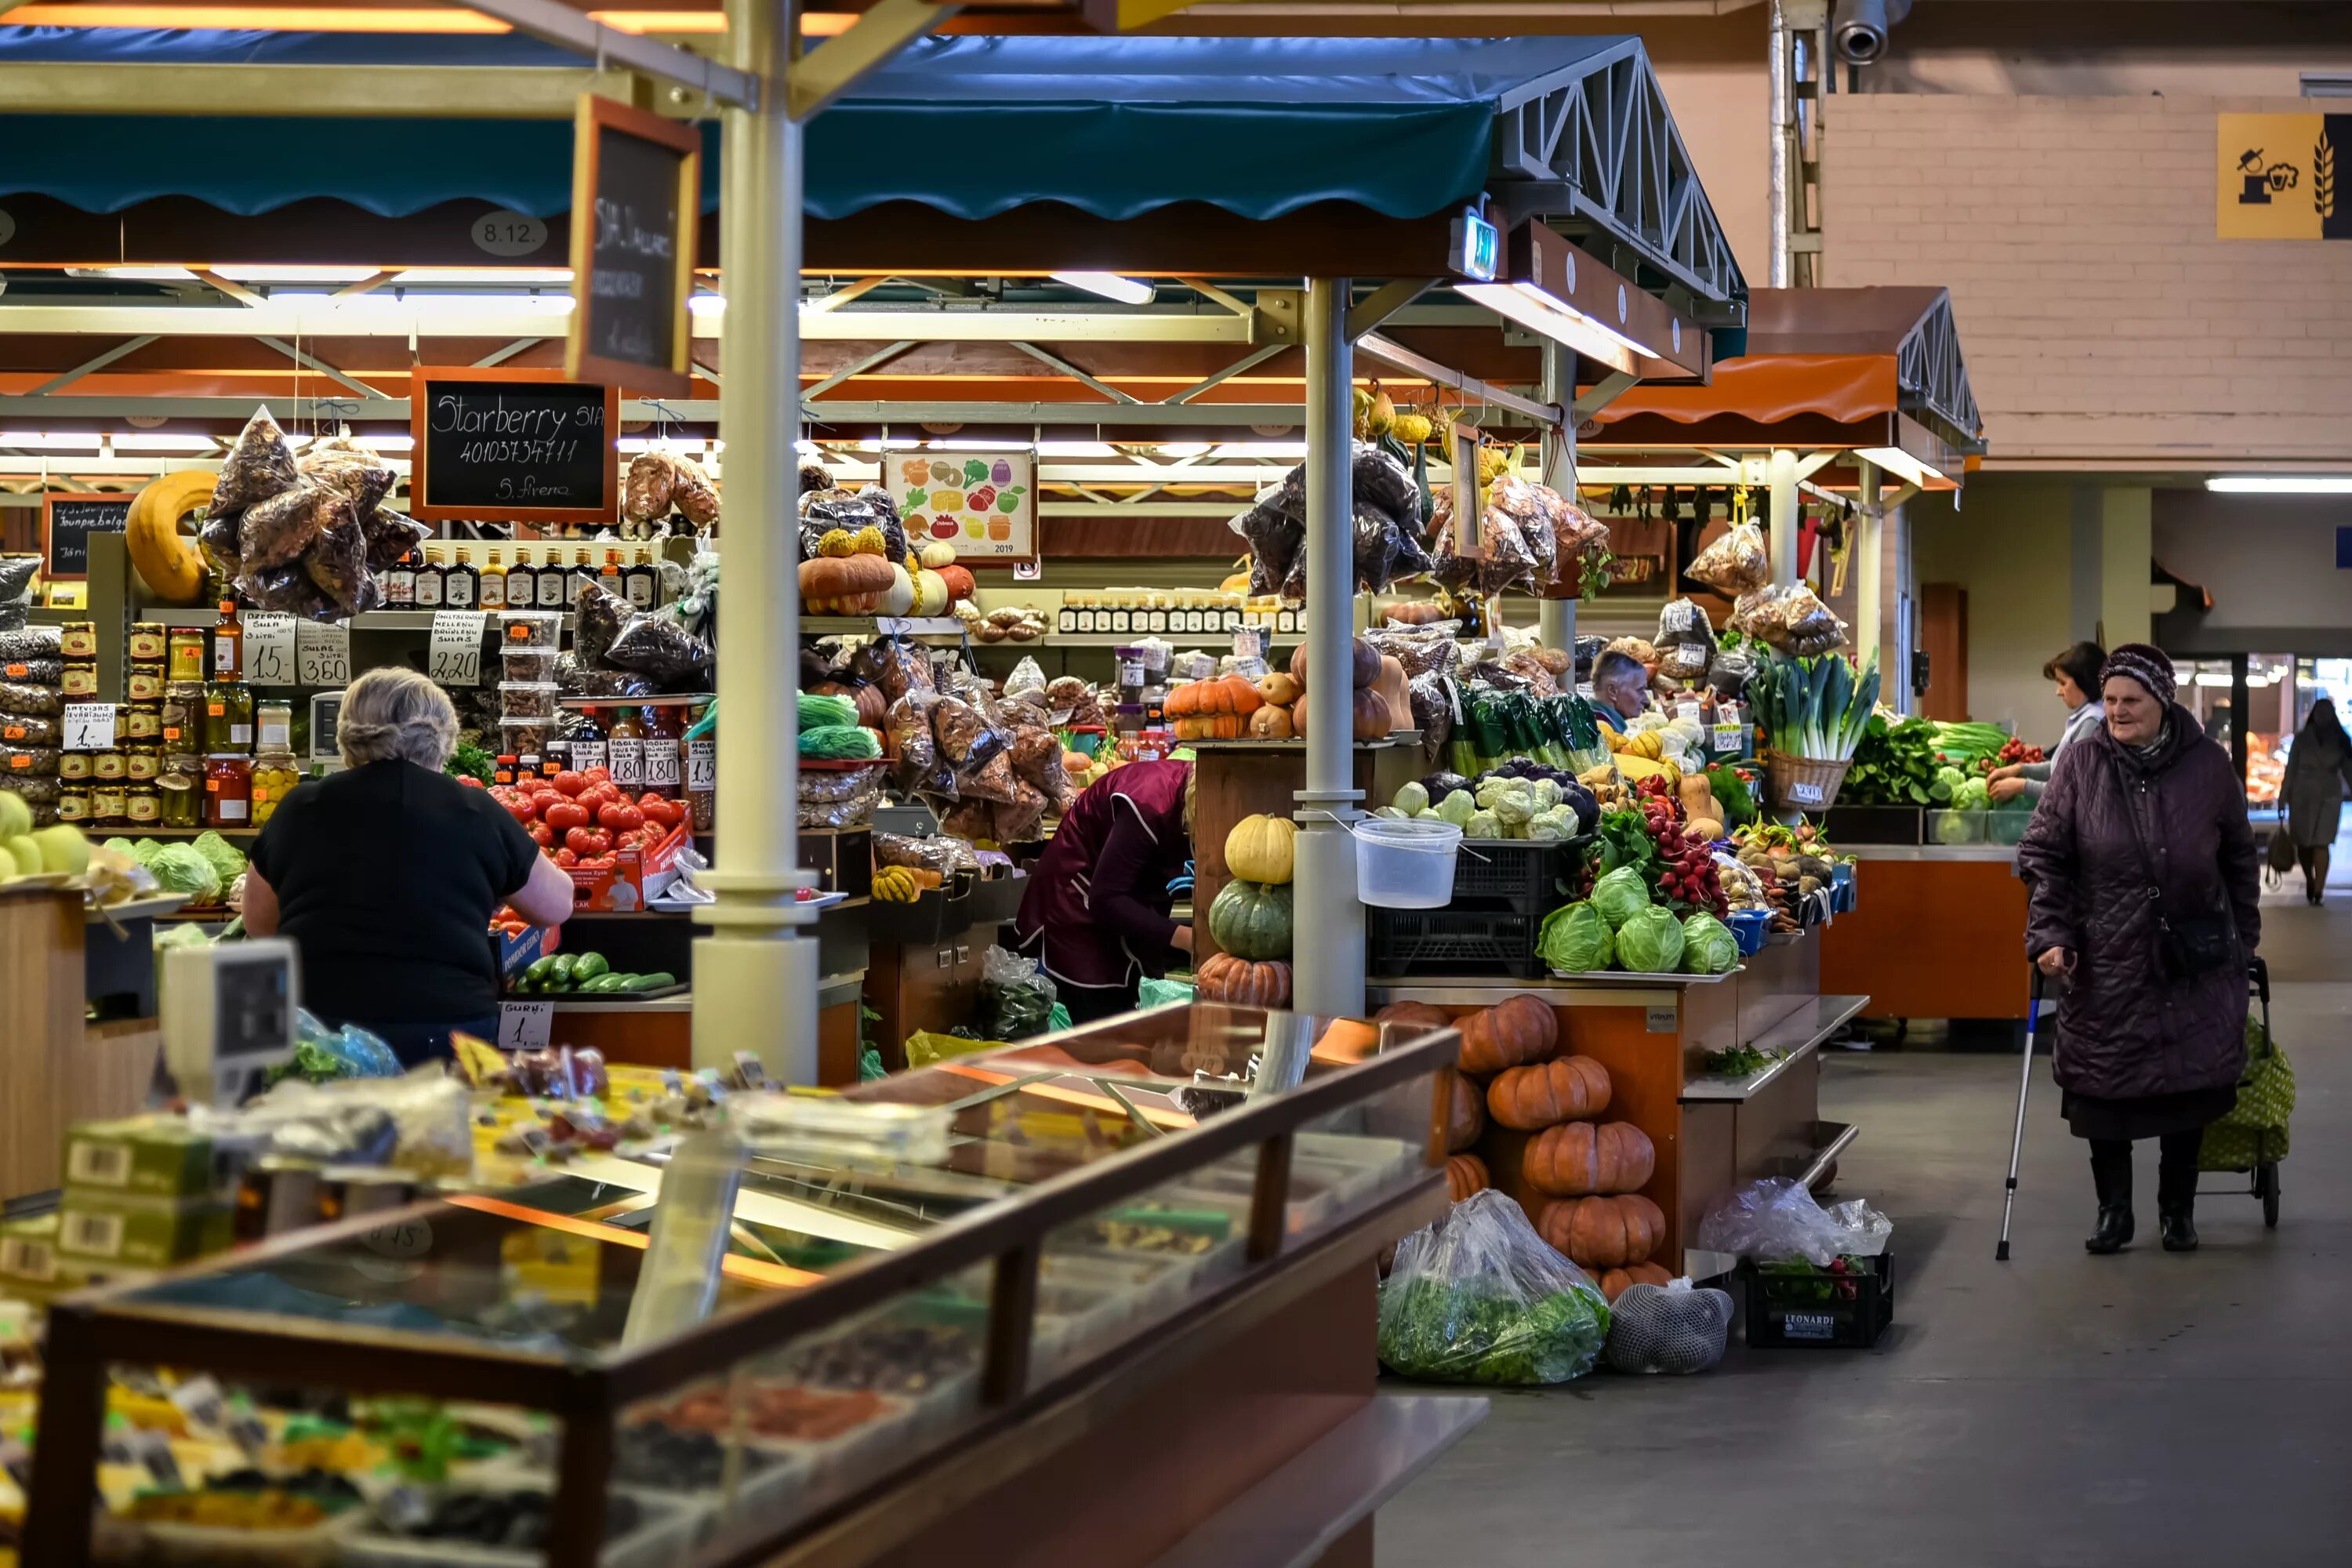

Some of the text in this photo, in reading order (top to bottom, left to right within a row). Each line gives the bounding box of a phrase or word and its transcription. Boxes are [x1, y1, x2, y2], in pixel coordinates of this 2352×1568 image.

[485, 223, 536, 242] 8.12.
[432, 394, 604, 441] Starberry SIA
[459, 439, 578, 464] 40103734711
[995, 544, 1014, 554] 2019
[303, 659, 347, 683] 3,60
[430, 652, 477, 681] 2,20
[612, 759, 642, 782] 1,80
[1785, 1315, 1835, 1325] LEONARDI
